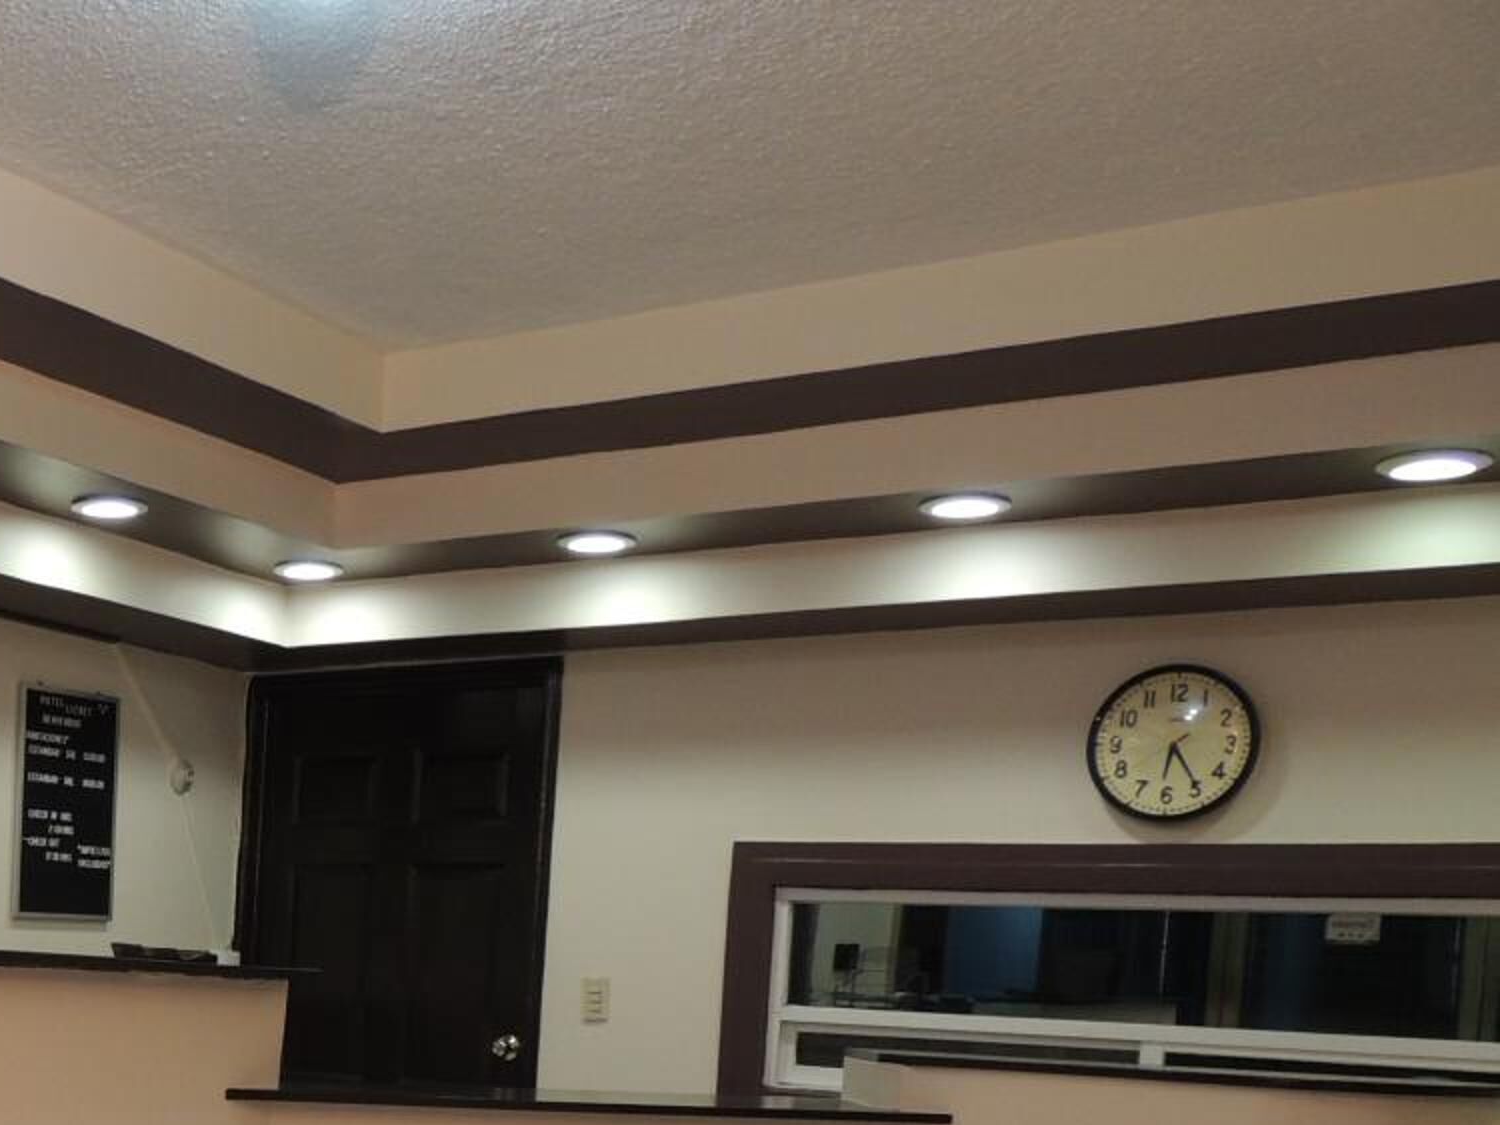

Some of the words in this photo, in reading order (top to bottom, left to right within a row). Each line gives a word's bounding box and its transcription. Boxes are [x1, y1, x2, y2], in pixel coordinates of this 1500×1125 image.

[1143, 690, 1156, 709] 11
[1170, 683, 1189, 703] 12
[1203, 689, 1209, 706] 1
[1120, 709, 1138, 728] 10
[1220, 708, 1233, 727] 2
[1109, 735, 1123, 754] 9
[1225, 735, 1237, 754] 3
[1114, 760, 1128, 779] 8
[1211, 761, 1226, 779] 4
[1135, 779, 1149, 798] 7
[1160, 786, 1173, 804] 6
[1188, 780, 1202, 799] 5
